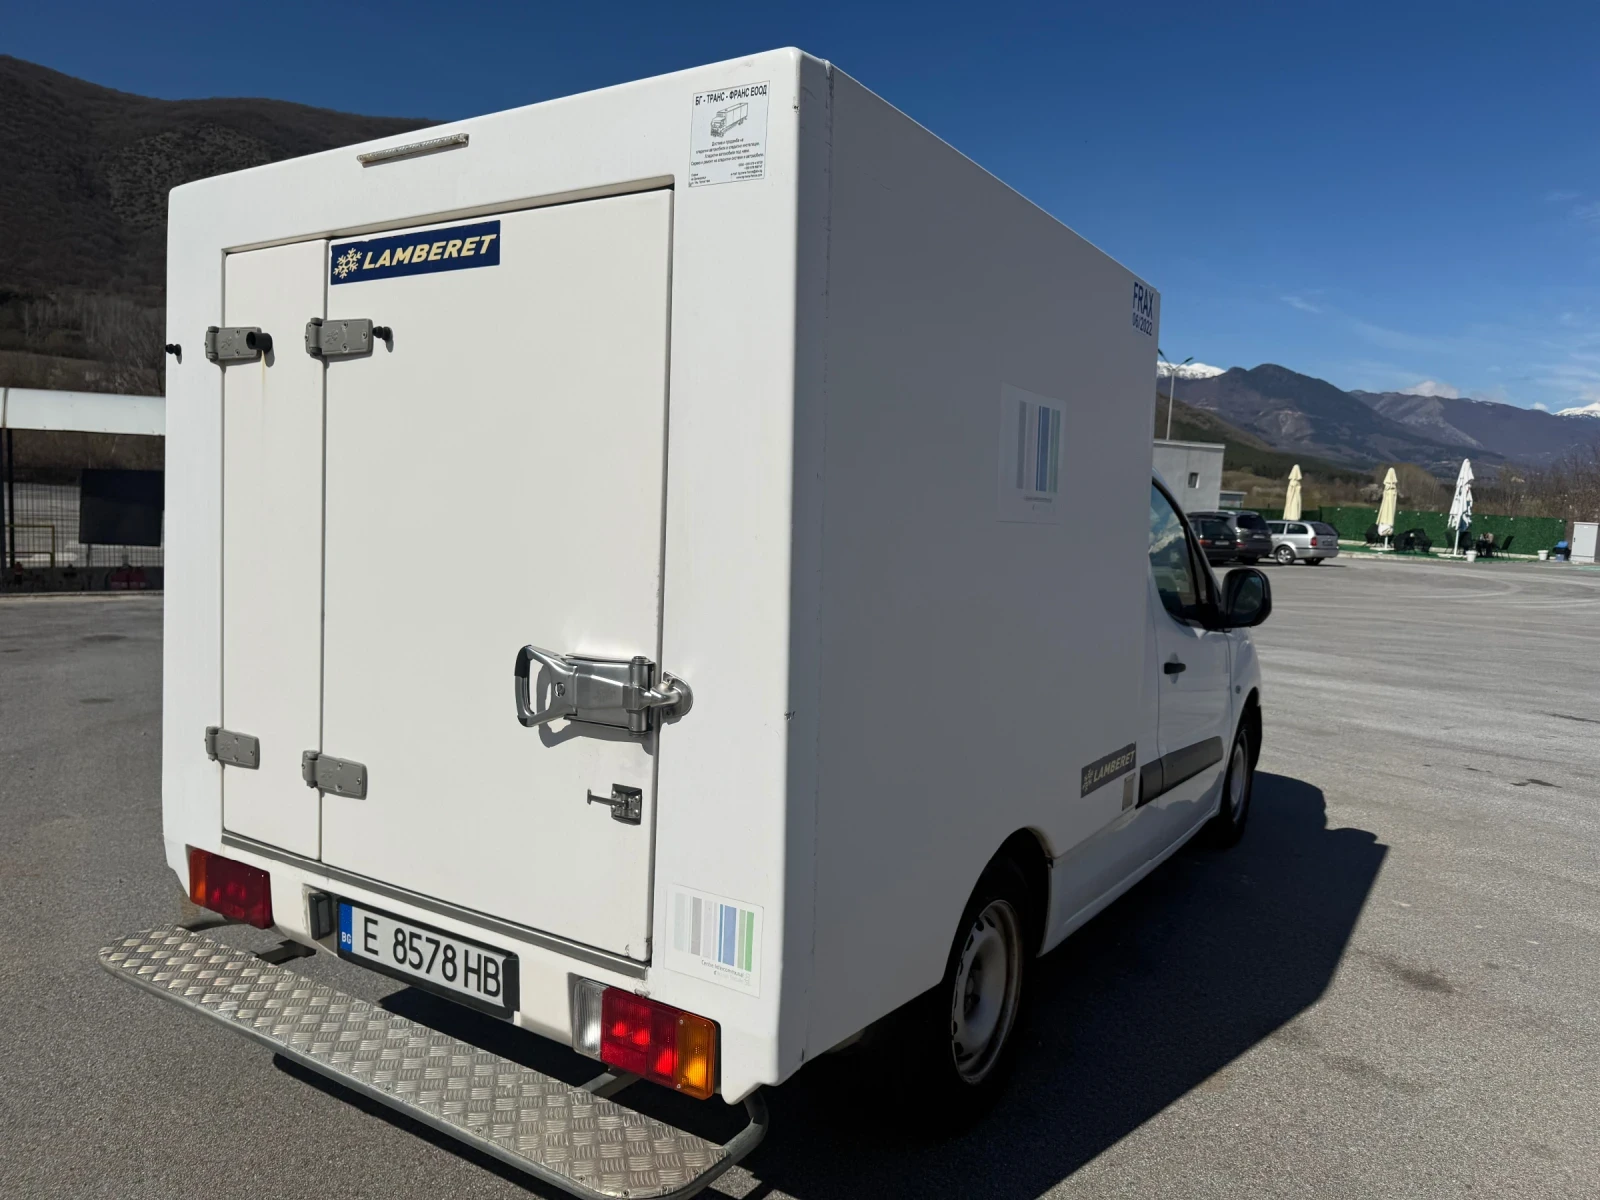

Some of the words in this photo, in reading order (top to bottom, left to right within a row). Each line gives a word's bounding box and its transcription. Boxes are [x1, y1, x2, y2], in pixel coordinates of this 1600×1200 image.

[695, 95, 703, 106] БГ
[706, 91, 725, 104] ТРАНС
[729, 87, 750, 100] ФРАНС
[750, 84, 767, 97] ЕООД
[362, 234, 497, 270] LAMBERET
[1132, 281, 1154, 320] FRAX
[1093, 750, 1135, 783] LAMBERET
[341, 931, 352, 945] BG
[363, 916, 379, 956] E
[392, 927, 458, 983] 8578
[463, 949, 501, 998] HB
